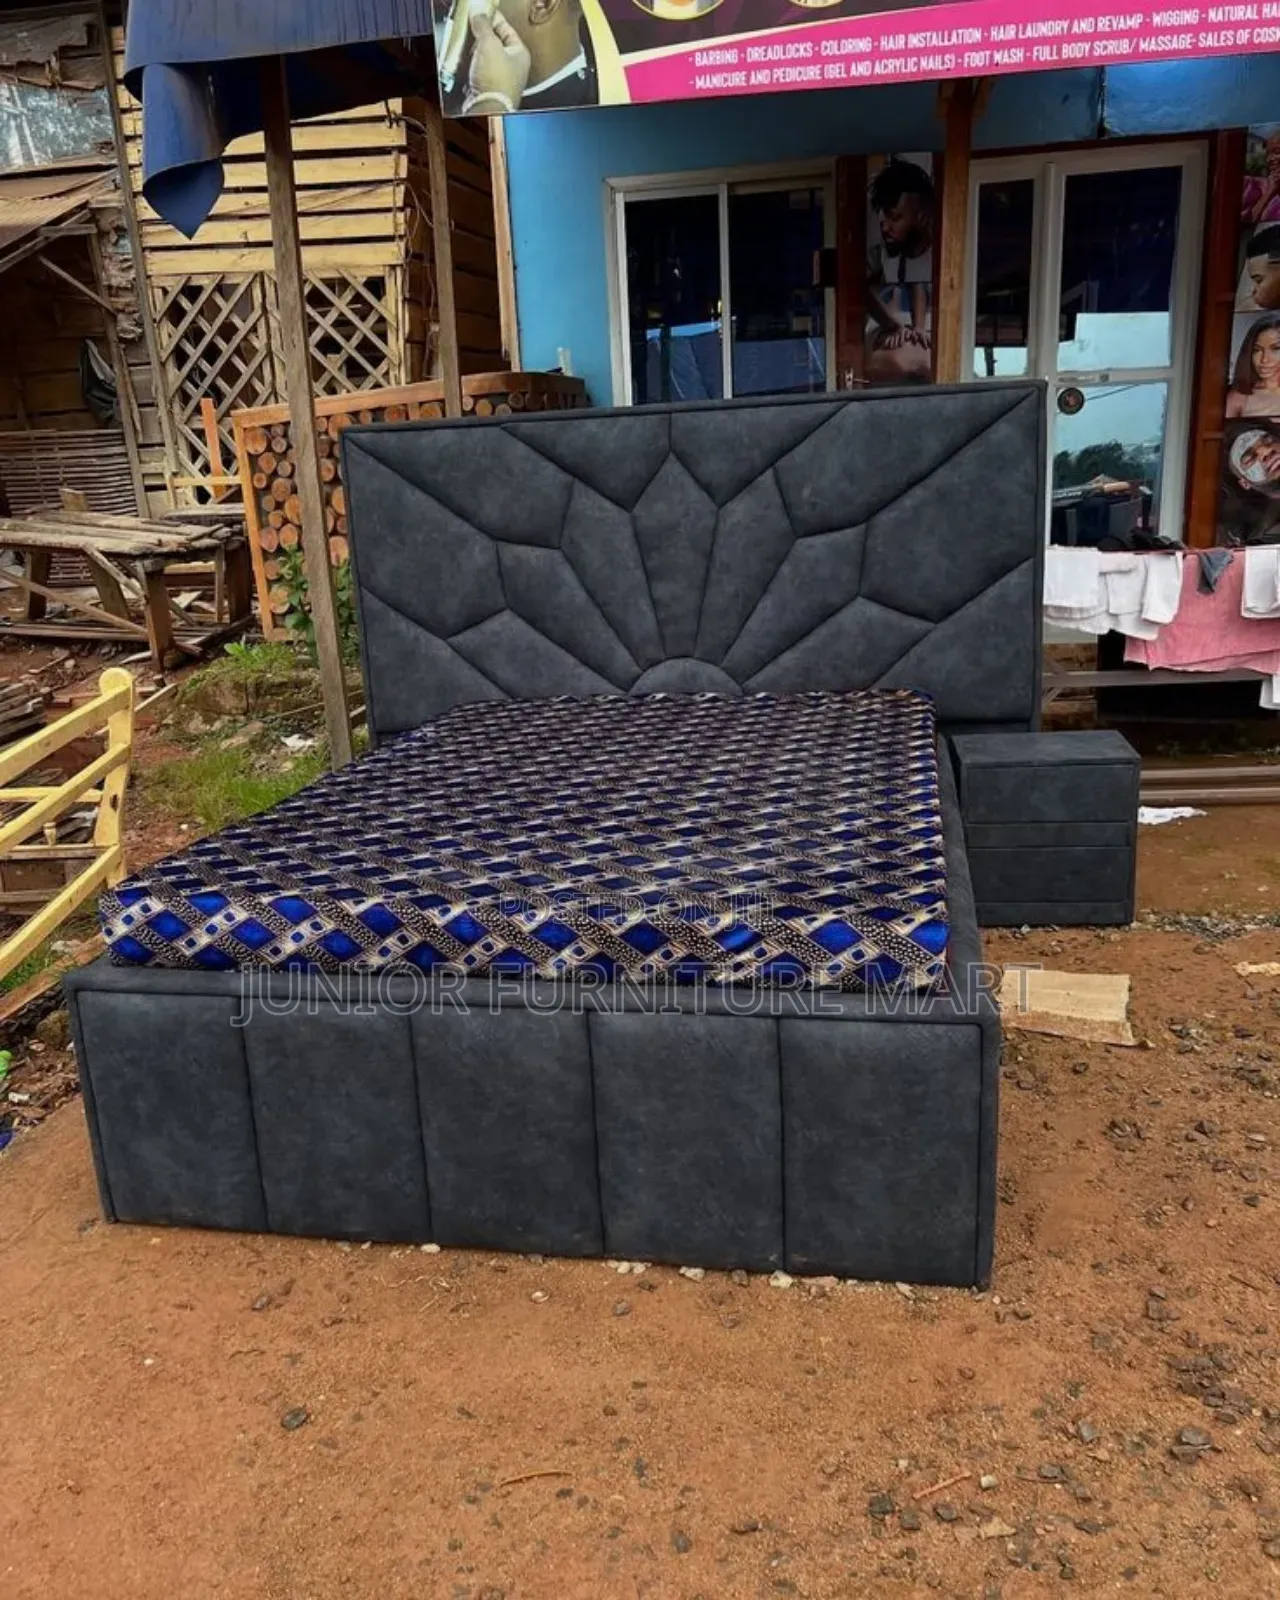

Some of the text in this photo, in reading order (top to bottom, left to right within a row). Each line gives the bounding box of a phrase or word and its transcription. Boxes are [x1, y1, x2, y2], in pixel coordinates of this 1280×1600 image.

[695, 48, 738, 67] BARBING
[746, 41, 813, 63] DREADLOCKS
[821, 36, 872, 56] COLORING
[880, 34, 905, 51] HAIR
[907, 28, 981, 48] INSTALLATION
[991, 24, 1016, 41] HAIR
[1019, 20, 1070, 38] LAUNDRY
[1071, 18, 1095, 34] AND
[1097, 13, 1143, 32] REVAMP
[1152, 9, 1199, 27] WIGGING
[1208, 4, 1259, 23] NATURAL
[695, 71, 747, 89] MANICURE
[749, 69, 771, 85] AND
[773, 65, 821, 83] PEDICURE
[850, 61, 872, 77] AND
[874, 57, 918, 75] ACRYLIC
[964, 50, 991, 68] FOOT
[993, 47, 1024, 65] WASH
[1032, 44, 1059, 62] FULL
[1062, 42, 1092, 59] BODY
[1198, 30, 1234, 48] SALES
[1236, 29, 1251, 44] OF
